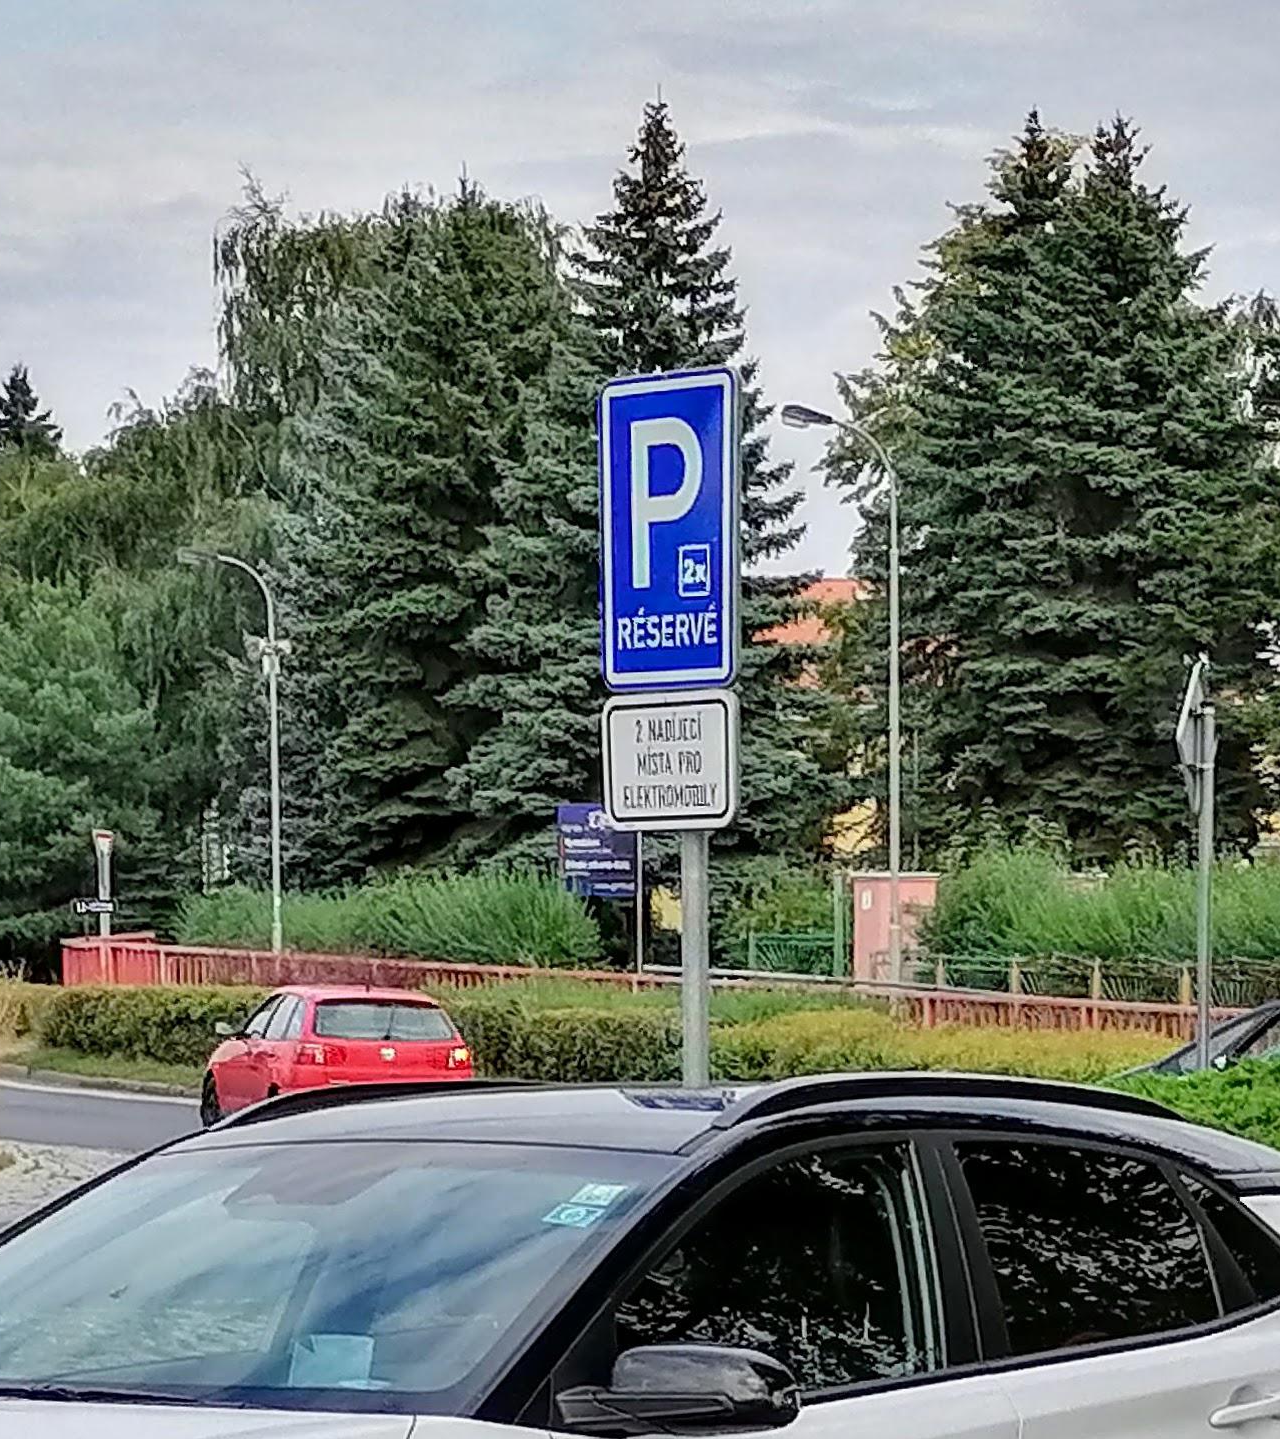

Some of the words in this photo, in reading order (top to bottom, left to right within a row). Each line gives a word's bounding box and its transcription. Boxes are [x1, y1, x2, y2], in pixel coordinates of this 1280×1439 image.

[629, 417, 703, 589] P
[683, 558, 706, 584] 2x
[617, 604, 719, 652] RÉSERVÉ
[635, 719, 643, 744] 2
[637, 747, 674, 776] MÍSTA
[678, 749, 703, 775] PRO
[623, 782, 718, 809] ELEKTROMOBILY
